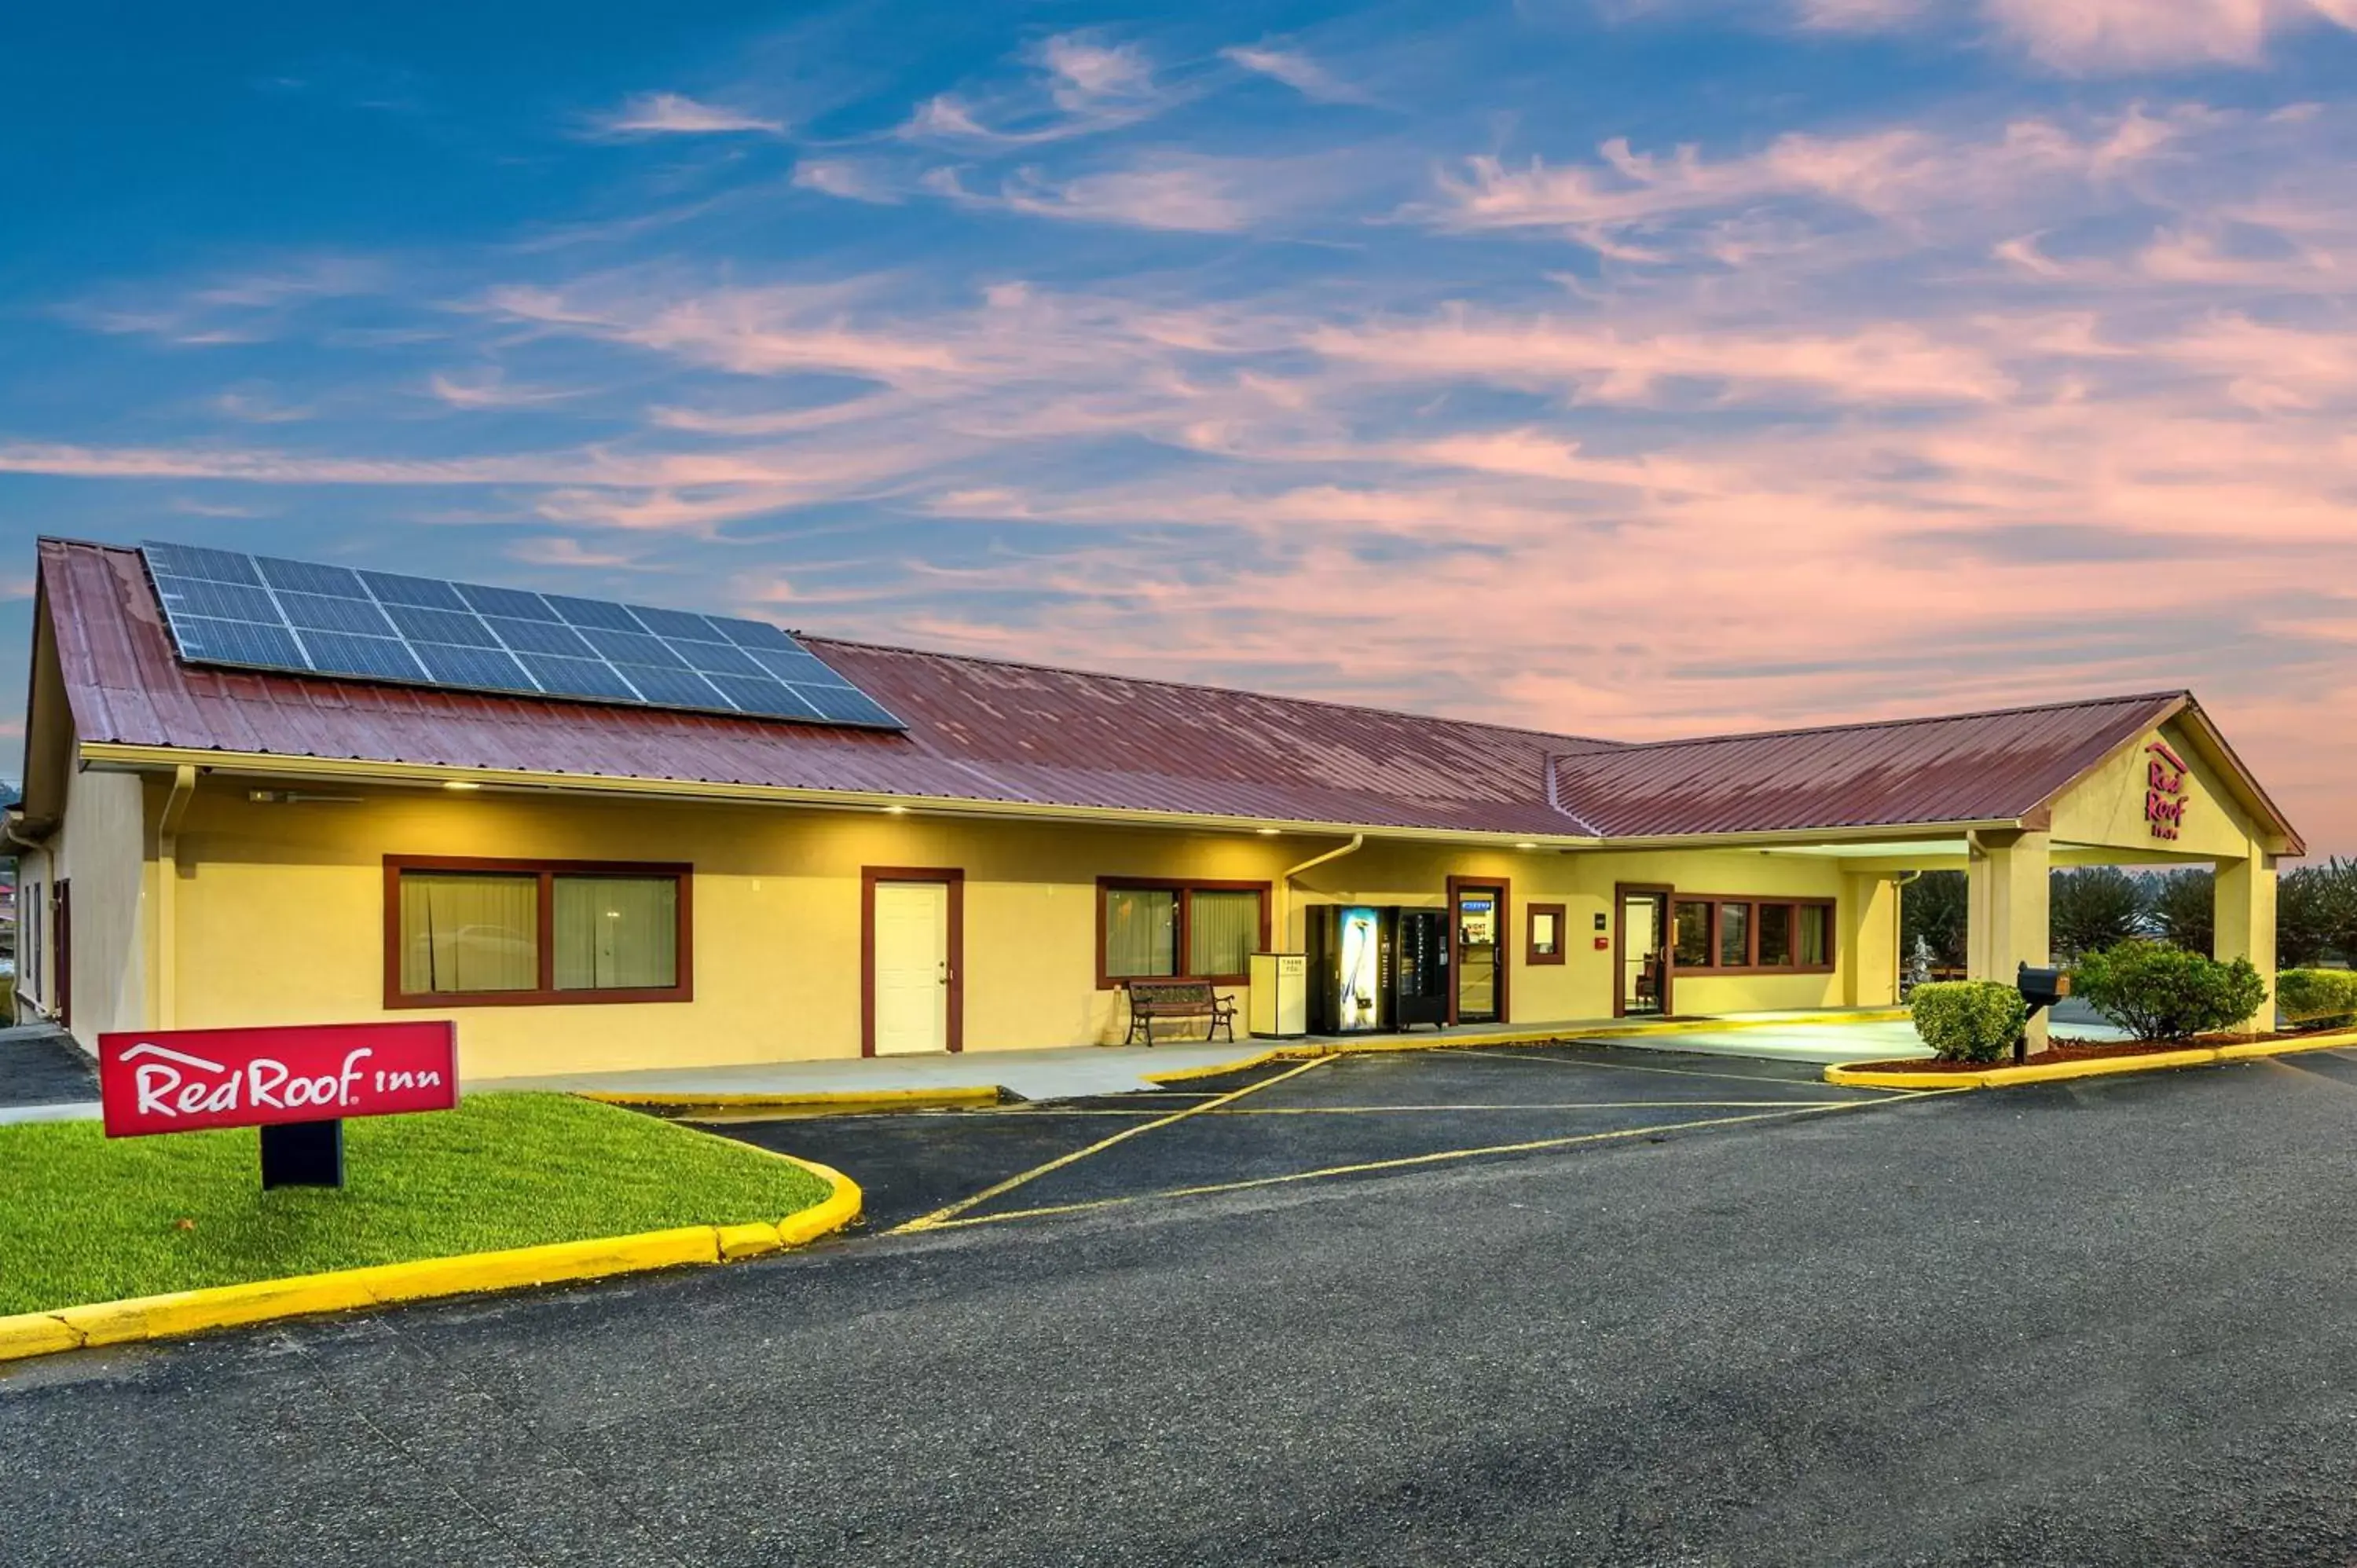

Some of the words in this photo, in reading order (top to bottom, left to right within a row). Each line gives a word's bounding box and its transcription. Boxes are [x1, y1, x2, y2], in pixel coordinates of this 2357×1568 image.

[2148, 759, 2181, 793] Red
[2144, 787, 2189, 827] Roof
[136, 1063, 243, 1117] Red
[247, 1047, 373, 1108] Roof
